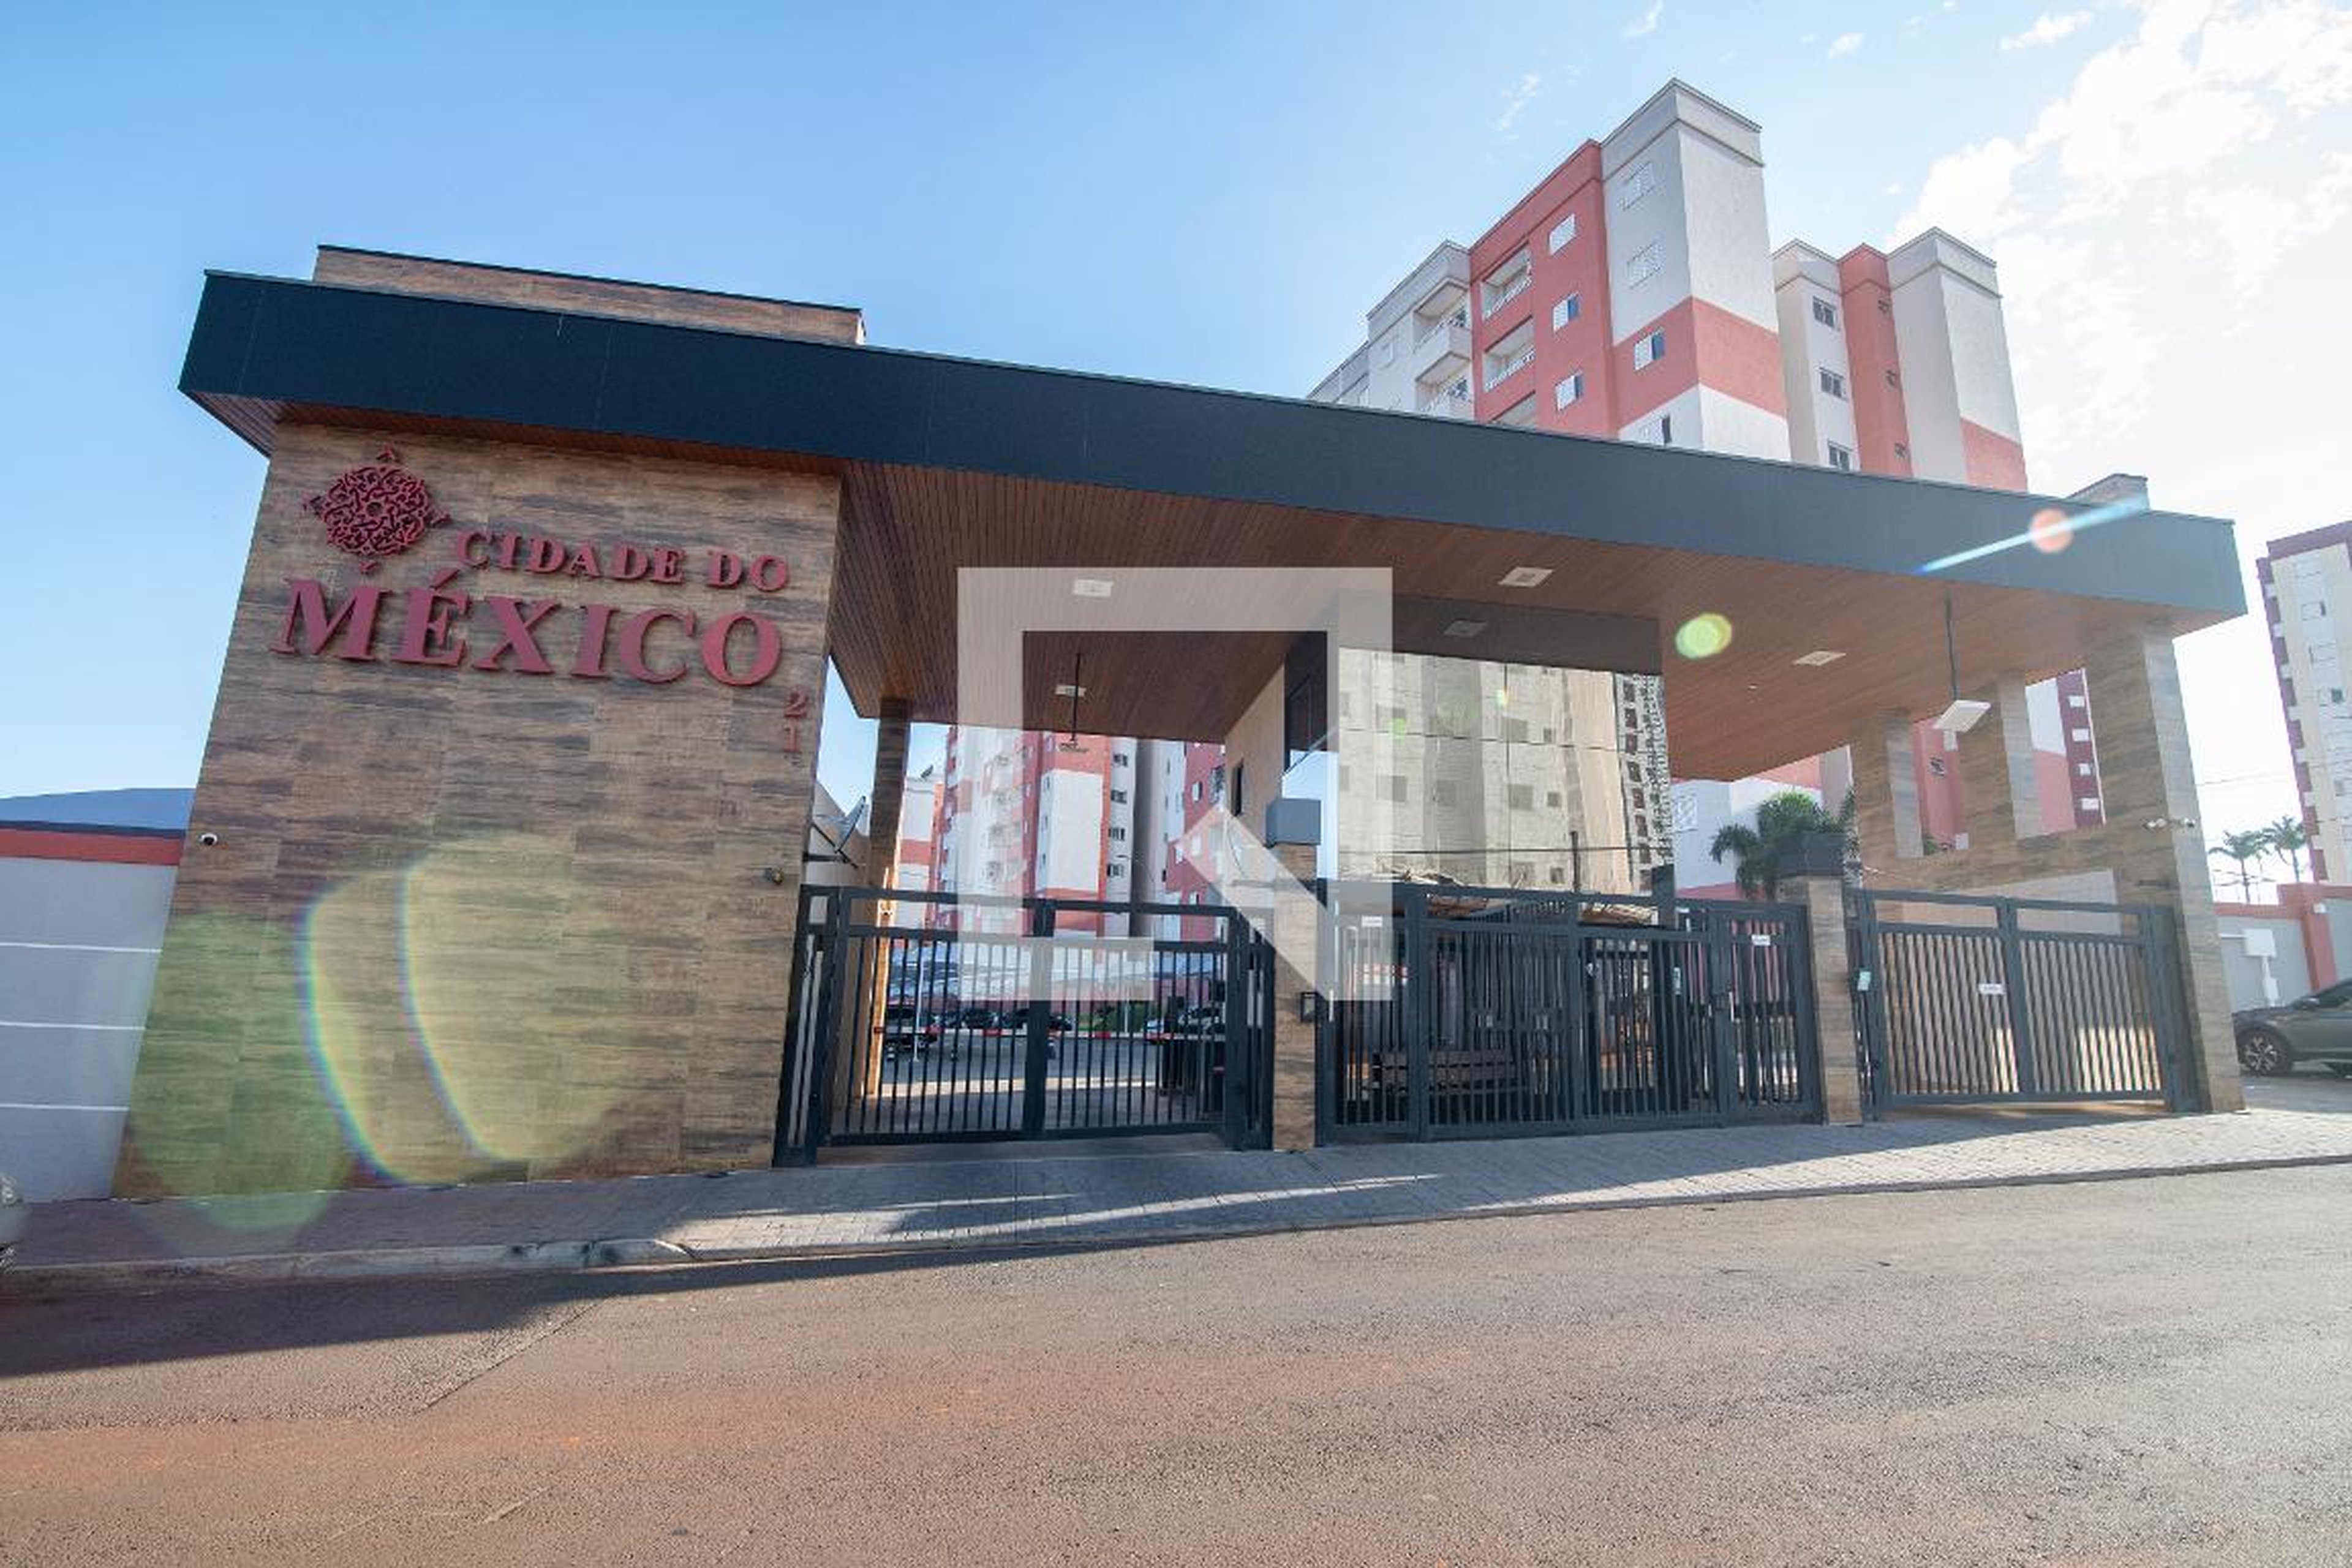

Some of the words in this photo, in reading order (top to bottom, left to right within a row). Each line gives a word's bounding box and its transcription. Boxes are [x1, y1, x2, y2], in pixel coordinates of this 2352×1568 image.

[456, 529, 686, 584] CIDADE
[706, 547, 790, 592] DO
[270, 567, 783, 687] MÉXICO
